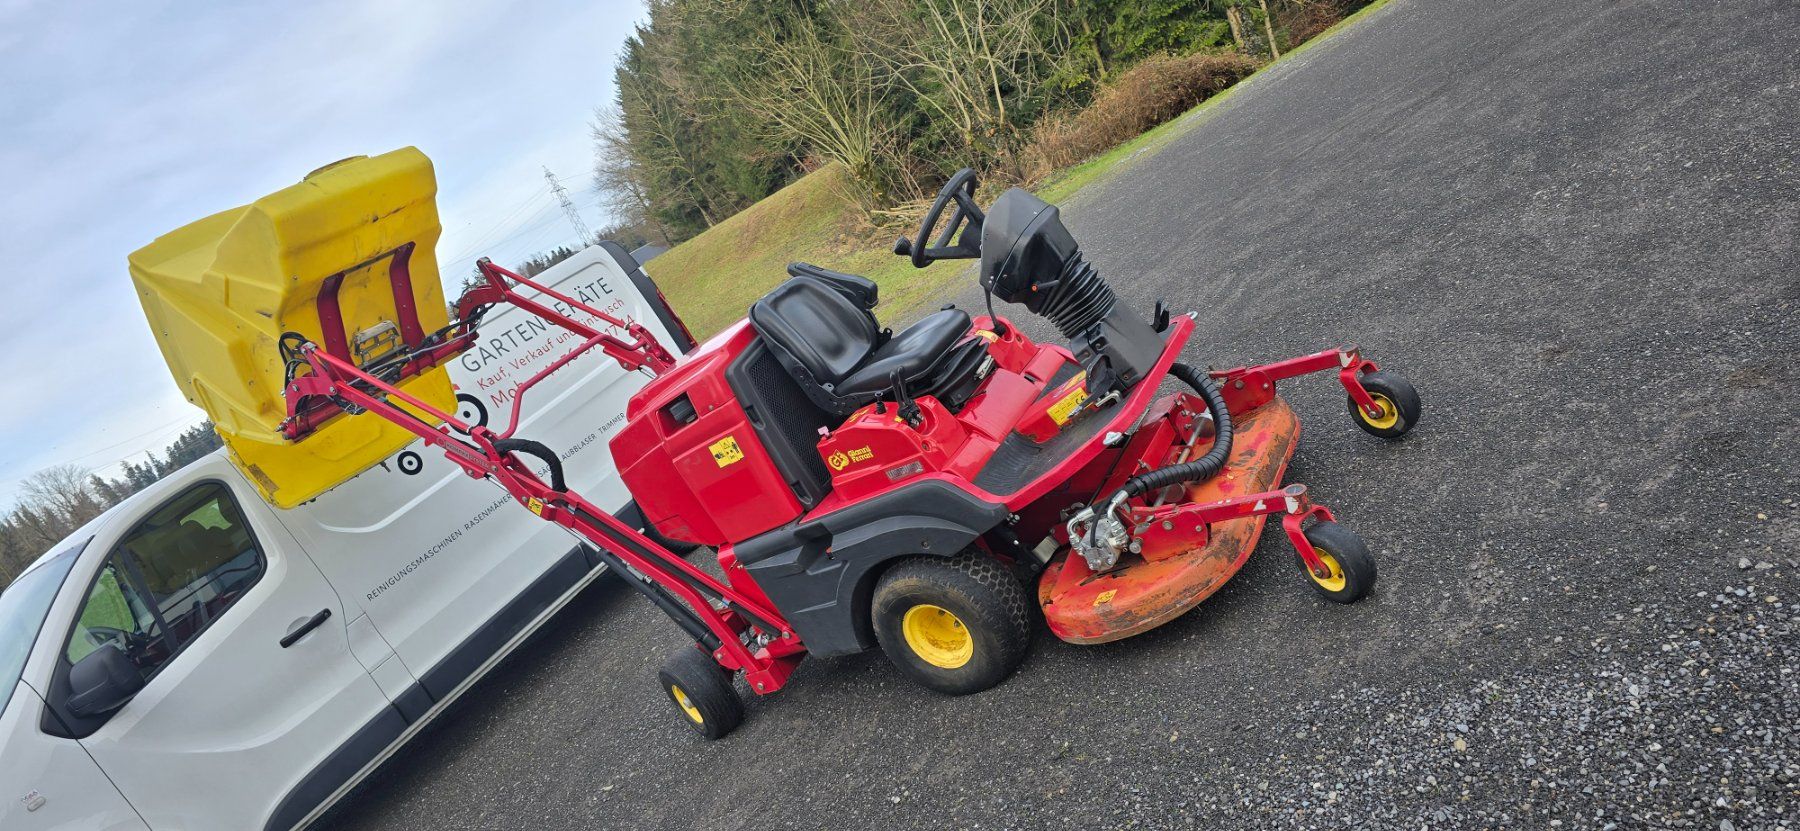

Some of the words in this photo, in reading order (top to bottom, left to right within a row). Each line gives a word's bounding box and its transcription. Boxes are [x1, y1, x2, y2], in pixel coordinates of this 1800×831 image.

[462, 277, 613, 372] GARTENEÄTE
[477, 367, 511, 391] Kauf,
[508, 340, 554, 368] Verkauf
[598, 411, 626, 434] TRIMMER
[851, 451, 874, 463] Ferrari
[366, 528, 463, 602] REINIGUNGSMASCHINEN
[464, 493, 513, 532] RASENMÄHER
